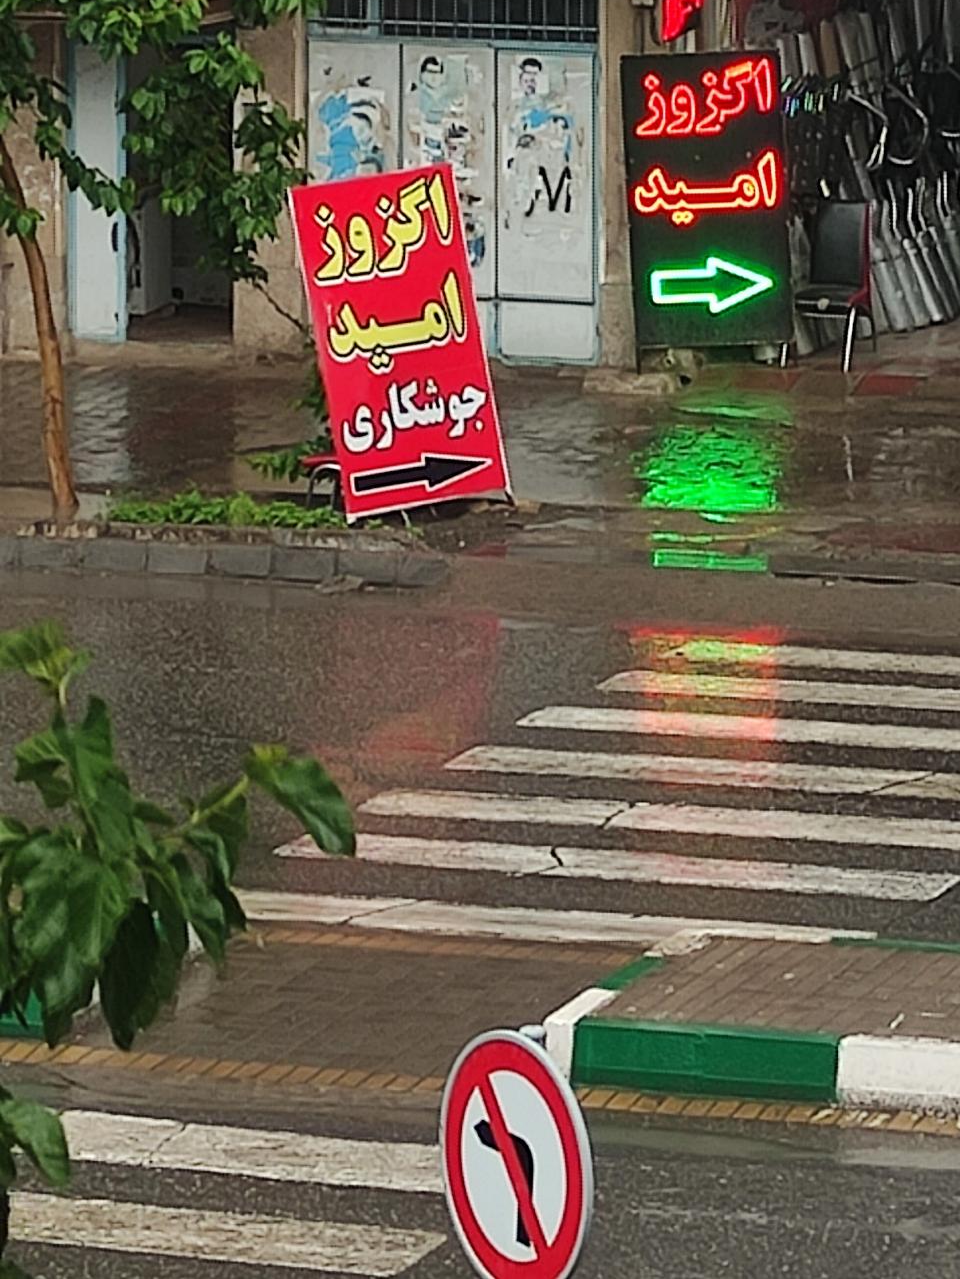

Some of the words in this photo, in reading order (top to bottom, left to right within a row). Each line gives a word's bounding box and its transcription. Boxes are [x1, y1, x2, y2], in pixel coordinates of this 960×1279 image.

[635, 57, 773, 137] اگزوز
[634, 150, 778, 226] امید
[314, 174, 452, 286] اگزوز
[327, 271, 468, 375] امید
[342, 377, 488, 453] جوشکاری
